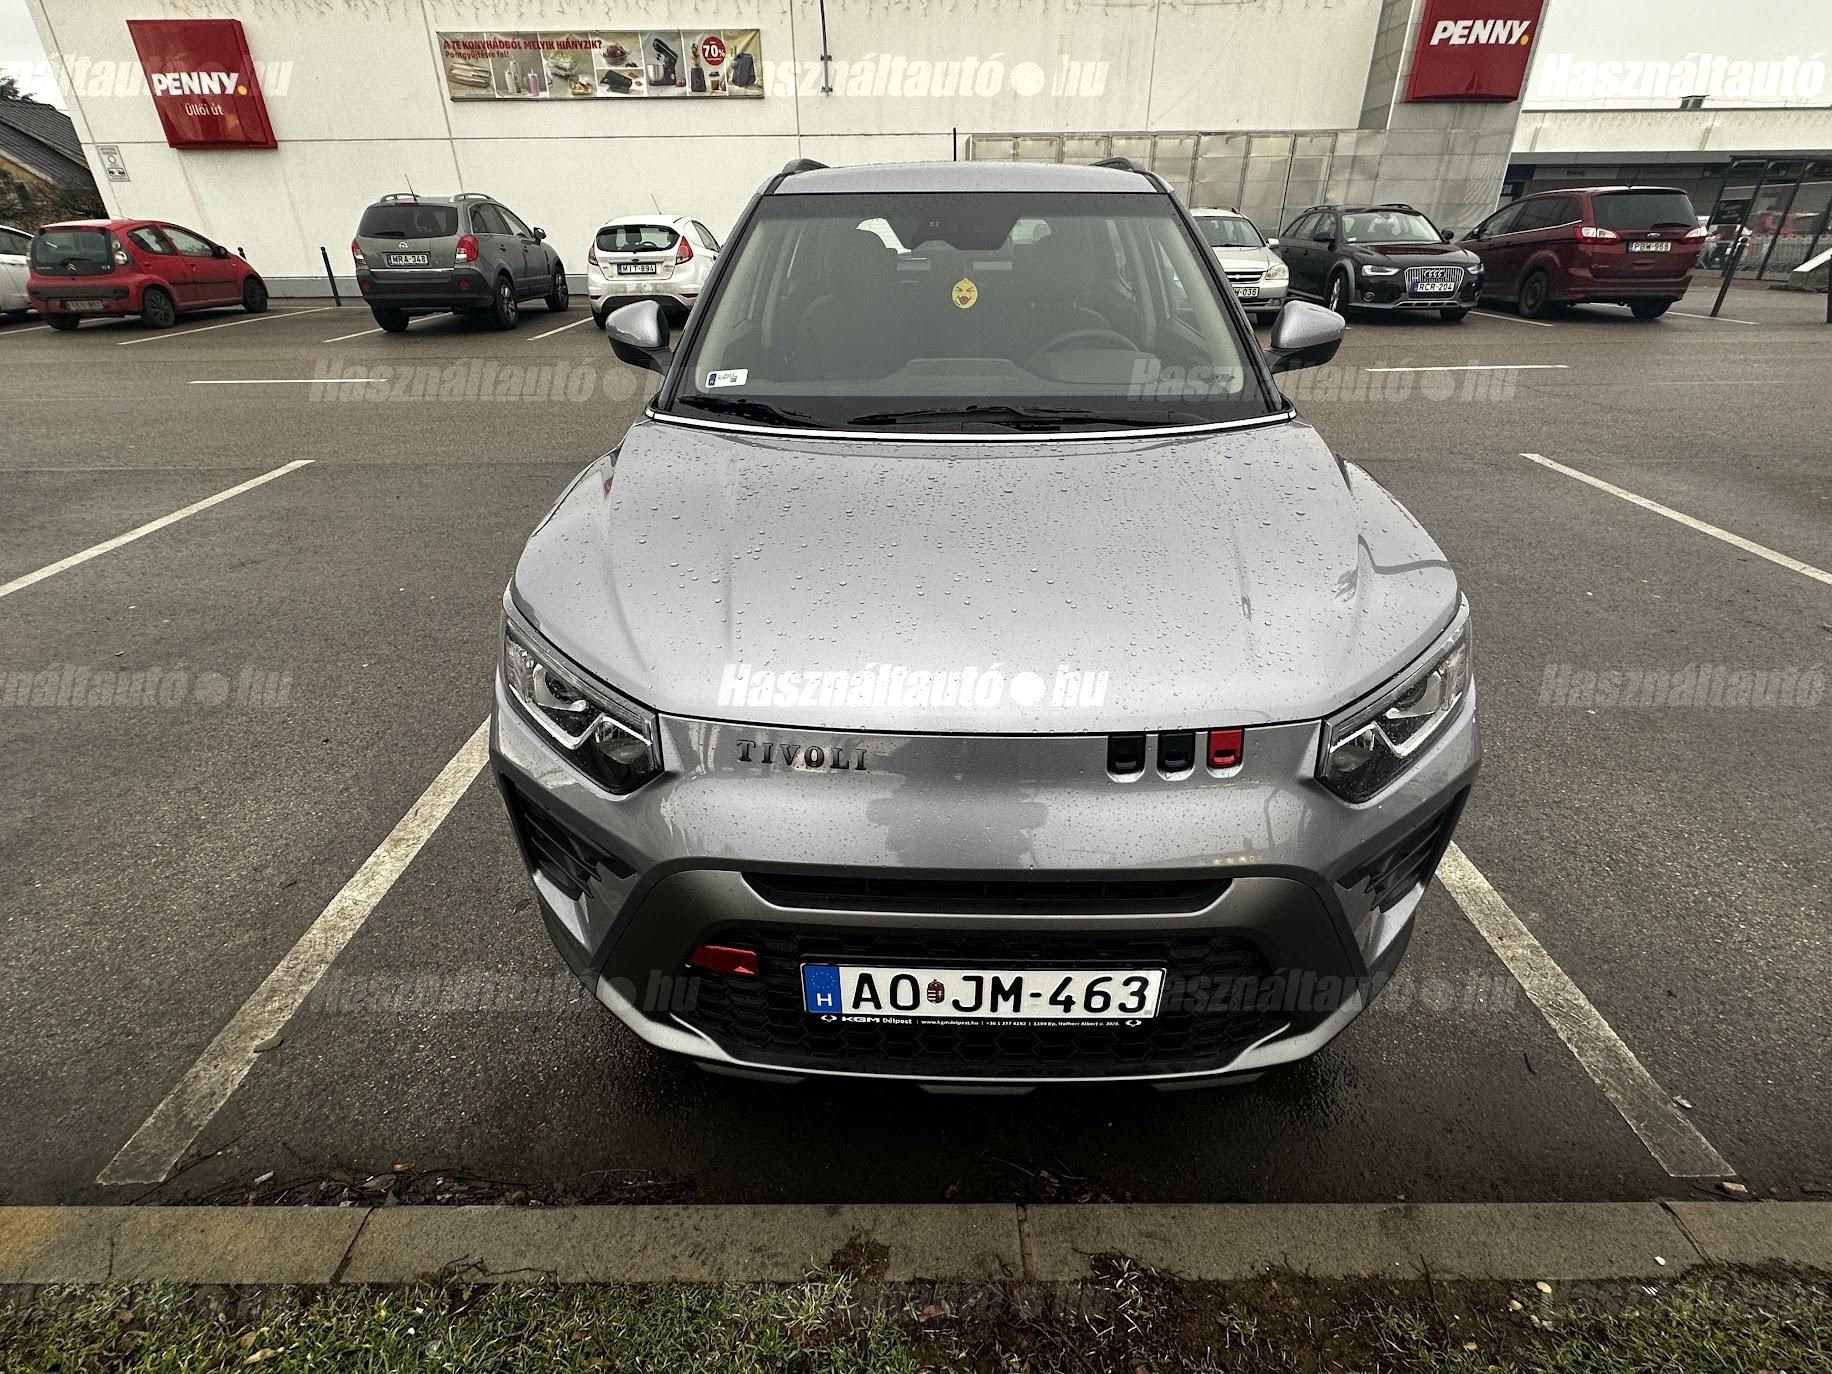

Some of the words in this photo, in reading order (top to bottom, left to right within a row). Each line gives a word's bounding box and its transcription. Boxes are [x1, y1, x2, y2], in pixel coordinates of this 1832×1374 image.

[443, 40, 450, 50] A
[451, 40, 461, 50] TE
[462, 37, 522, 50] KONYHÁDBÓL
[524, 40, 555, 50] MELYIK
[557, 37, 603, 50] HIÁNYZIK?
[702, 44, 726, 58] 70%
[185, 102, 209, 116] Üllői
[211, 102, 224, 116] út
[735, 739, 868, 771] TIVOLI
[816, 992, 833, 1008] H
[851, 972, 921, 1012] AO
[951, 974, 1150, 1014] JM-463
[841, 1016, 881, 1024] KGM
[882, 1016, 913, 1025] Délpest
